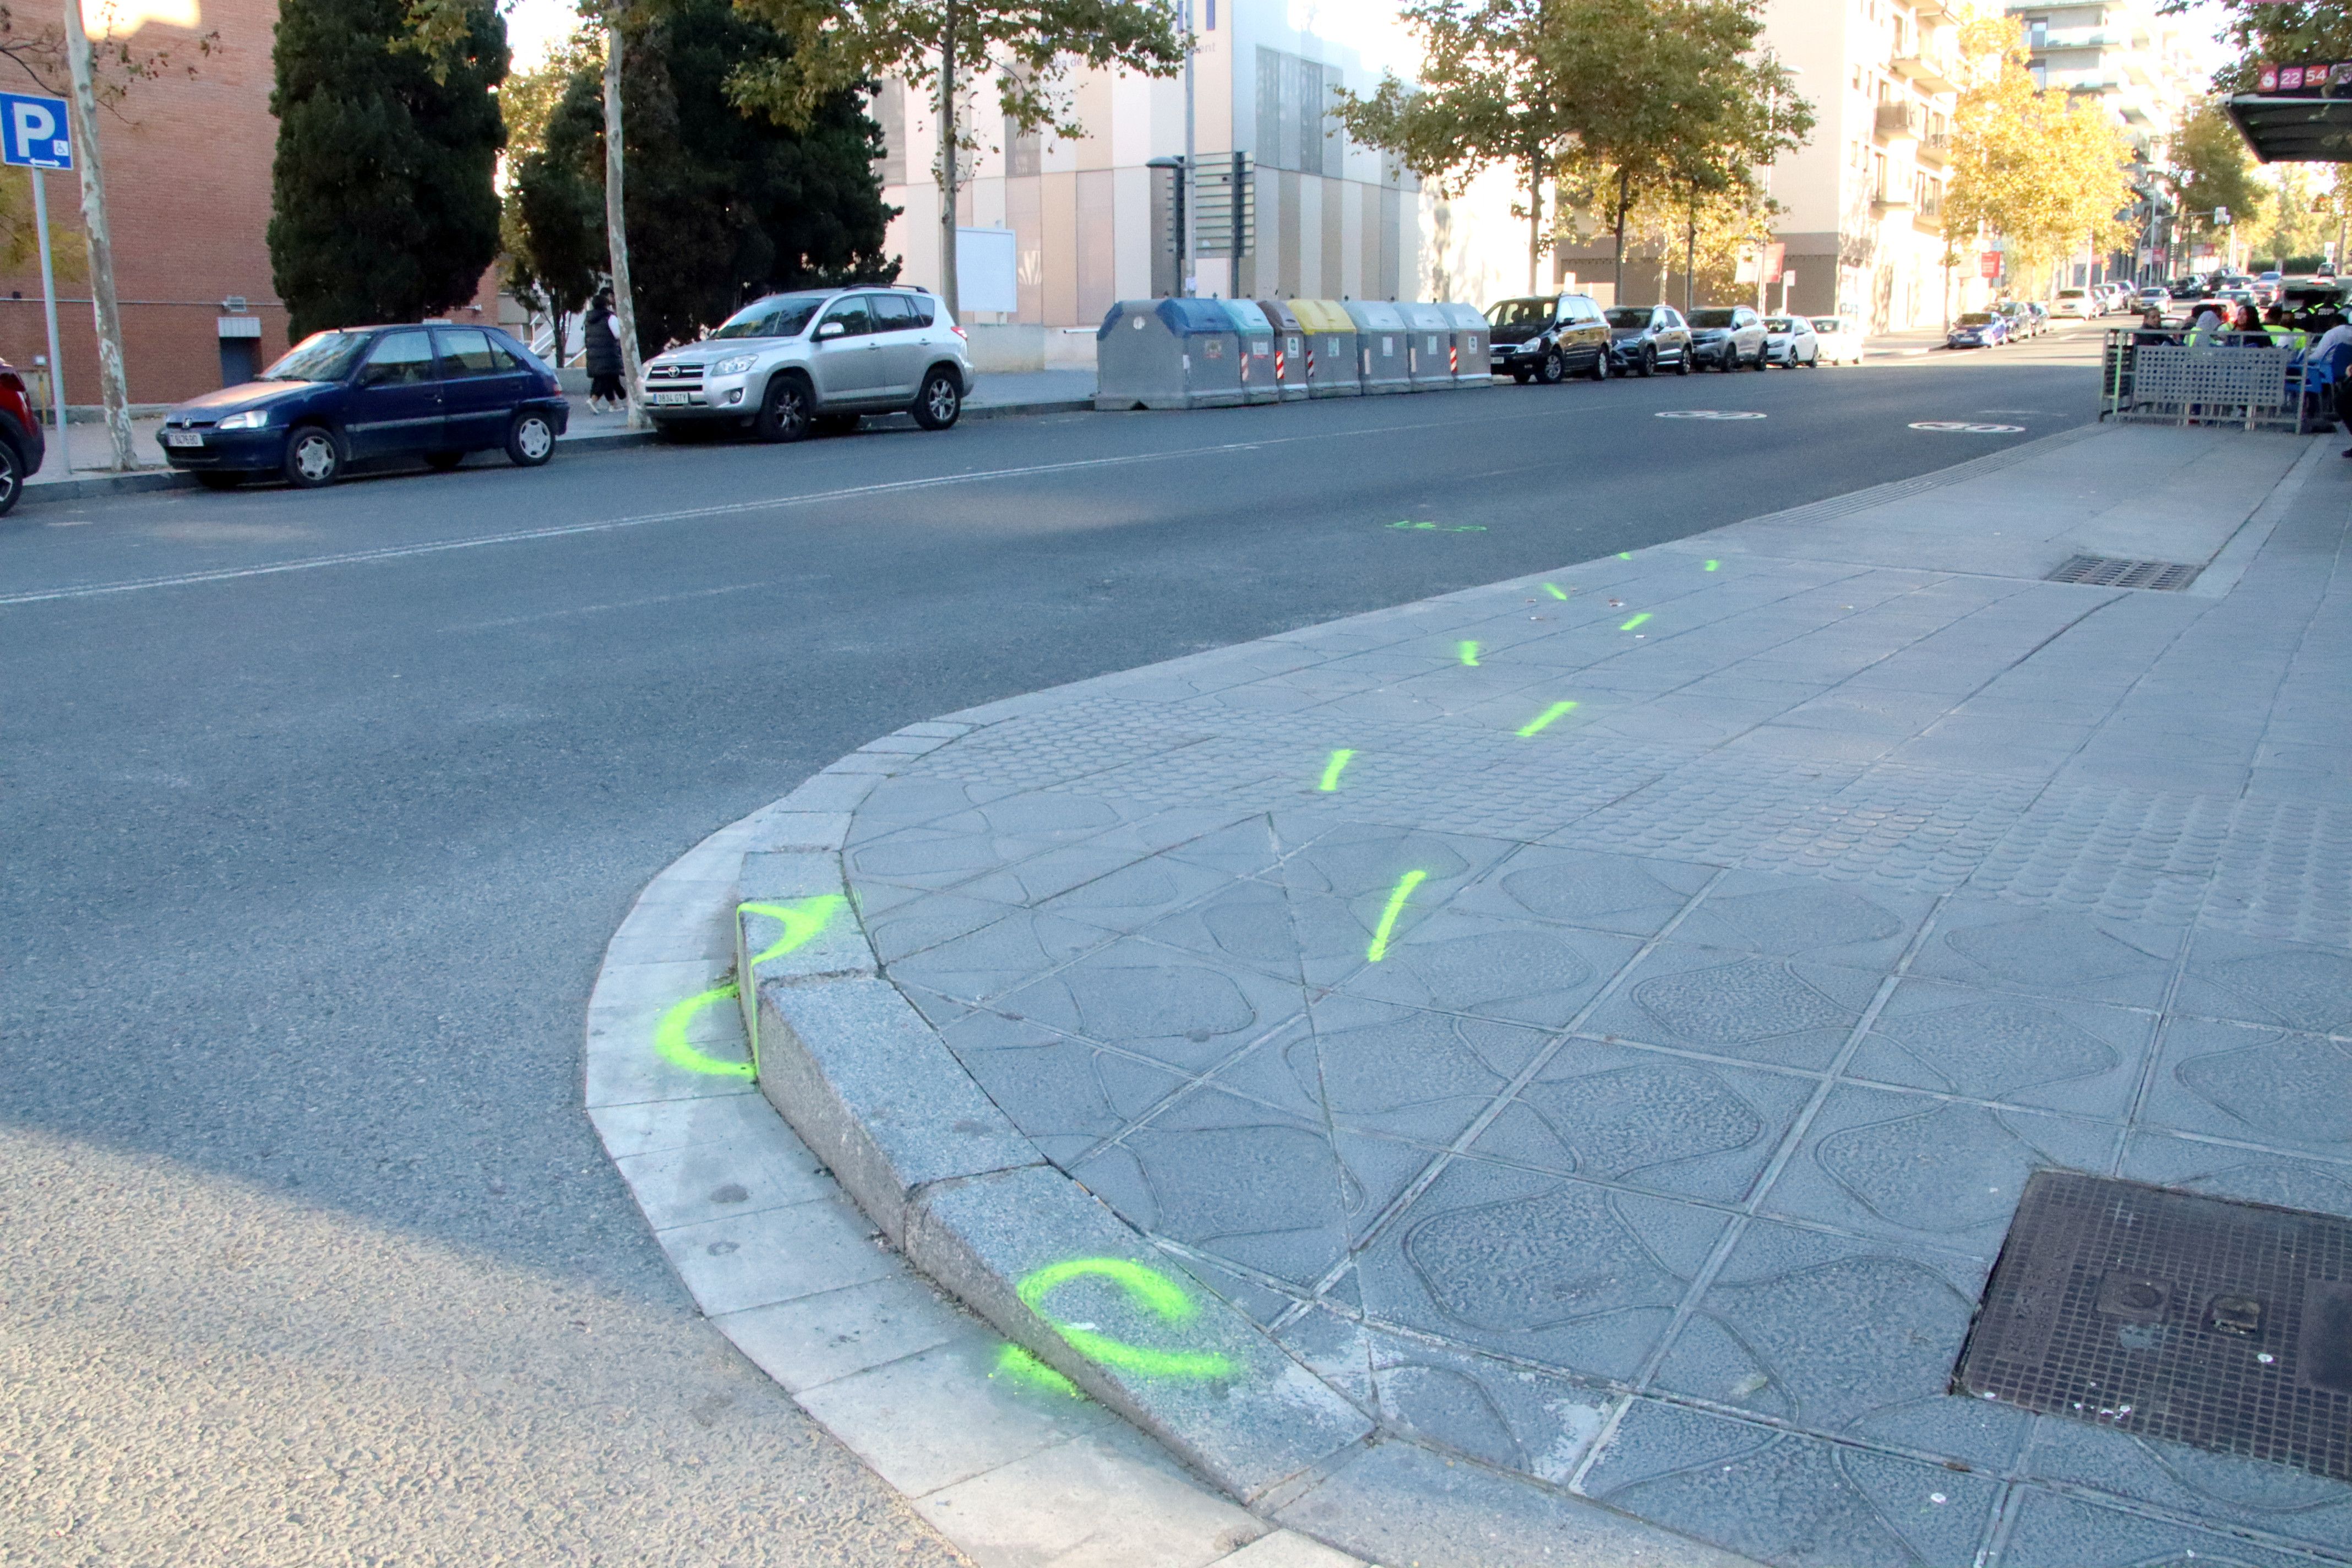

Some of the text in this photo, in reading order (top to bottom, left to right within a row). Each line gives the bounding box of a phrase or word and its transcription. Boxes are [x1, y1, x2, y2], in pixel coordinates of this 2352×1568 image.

[2280, 72, 2301, 84] 22
[2306, 69, 2326, 82] 54
[13, 102, 55, 157] P
